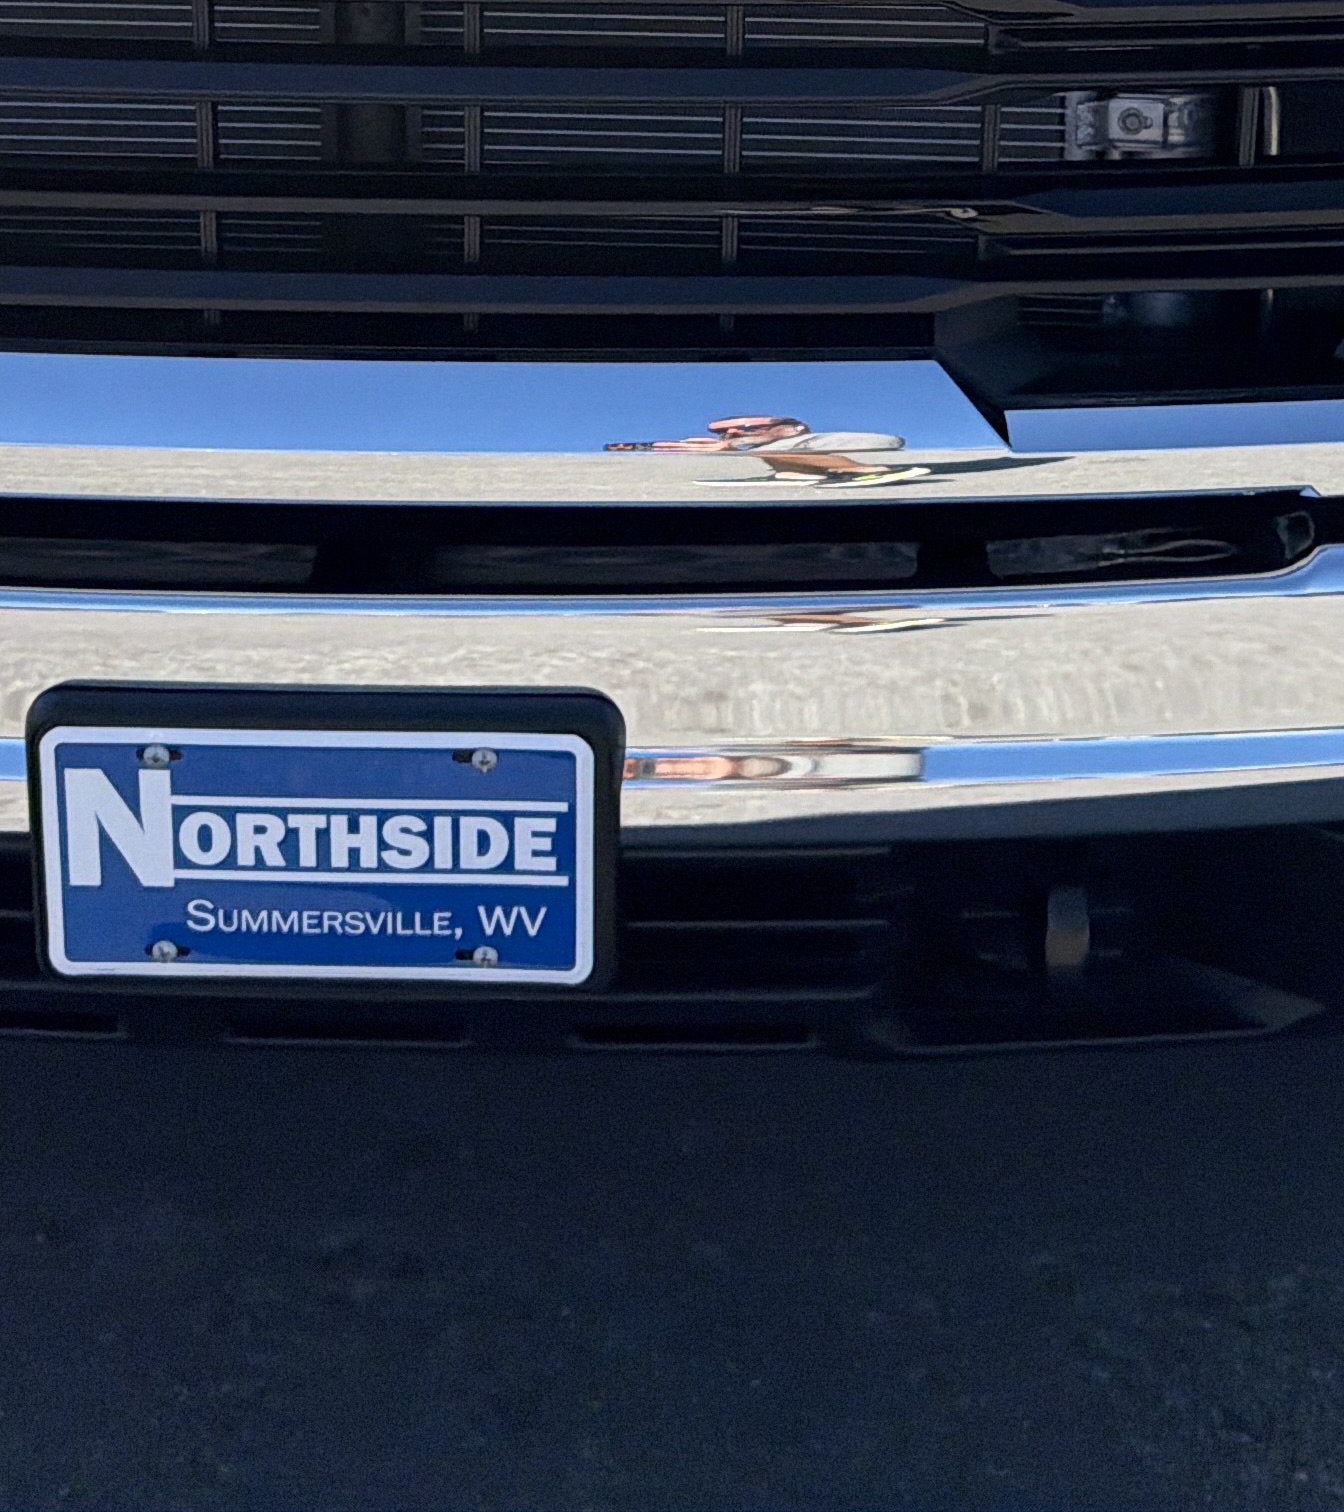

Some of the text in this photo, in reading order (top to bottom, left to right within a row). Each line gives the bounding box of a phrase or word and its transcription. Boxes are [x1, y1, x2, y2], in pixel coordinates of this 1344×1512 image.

[63, 767, 558, 888] NORTHSIDE
[185, 898, 548, 941] SUMMERSVILLE, WV
